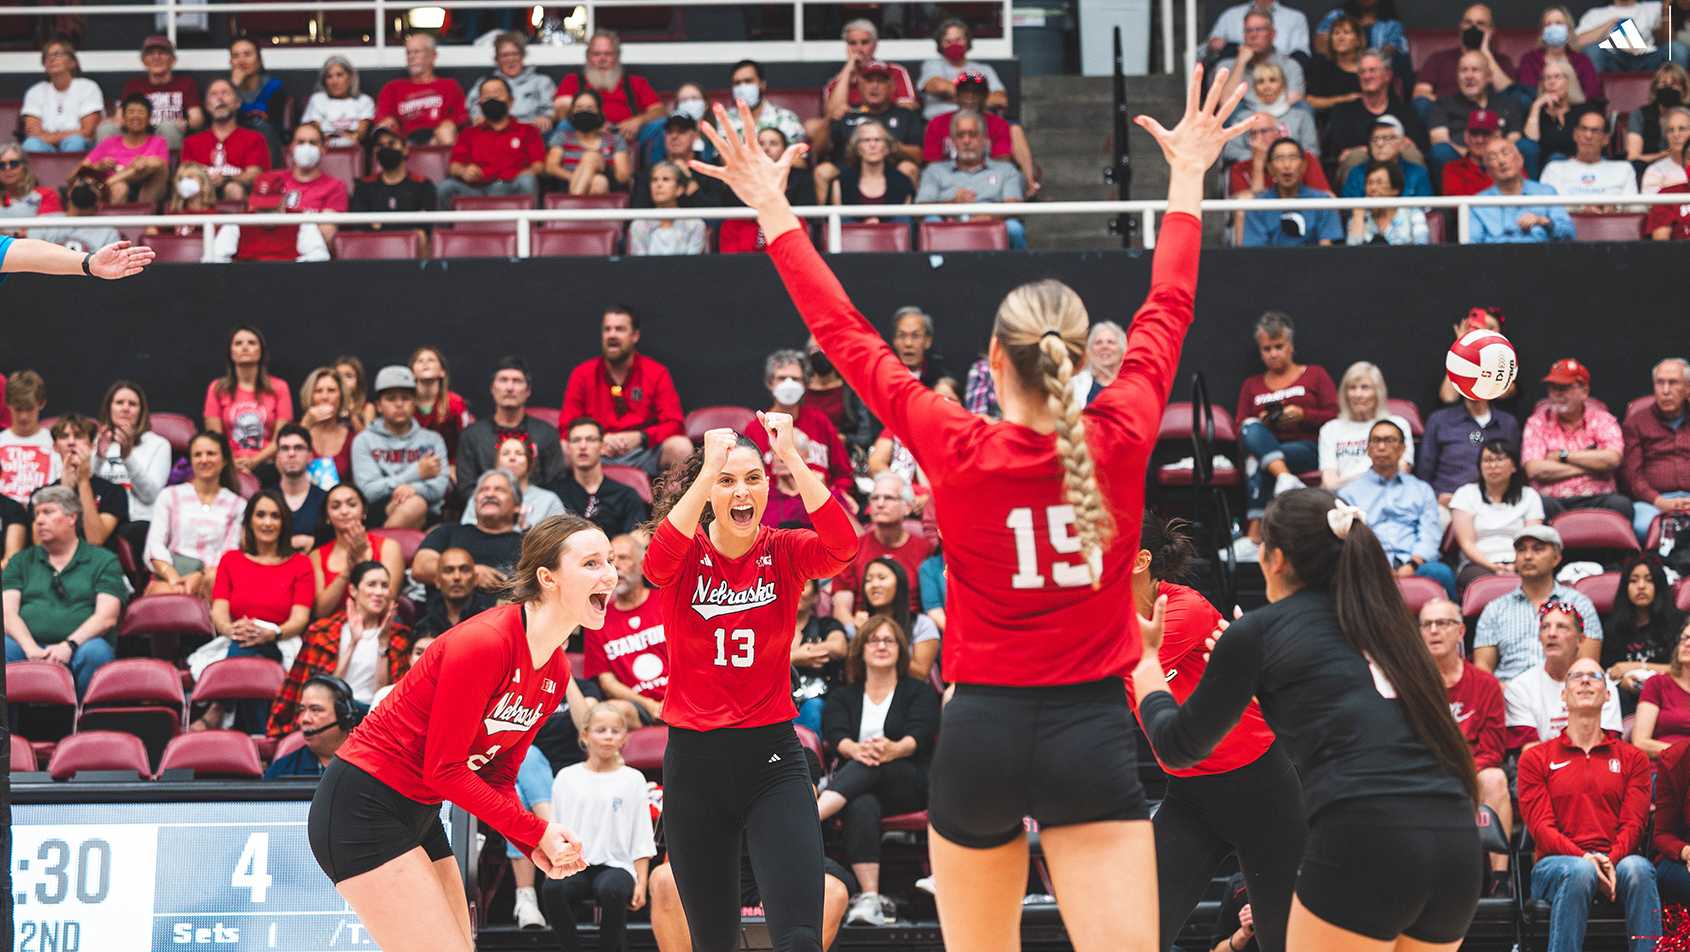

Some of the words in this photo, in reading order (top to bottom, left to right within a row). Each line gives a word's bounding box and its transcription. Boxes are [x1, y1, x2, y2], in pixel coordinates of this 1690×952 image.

[1006, 505, 1104, 589] 15
[691, 574, 778, 605] Nebraska
[713, 627, 756, 668] 13
[231, 831, 273, 902] 4
[20, 920, 81, 952] 2ND
[172, 921, 241, 945] Sets
